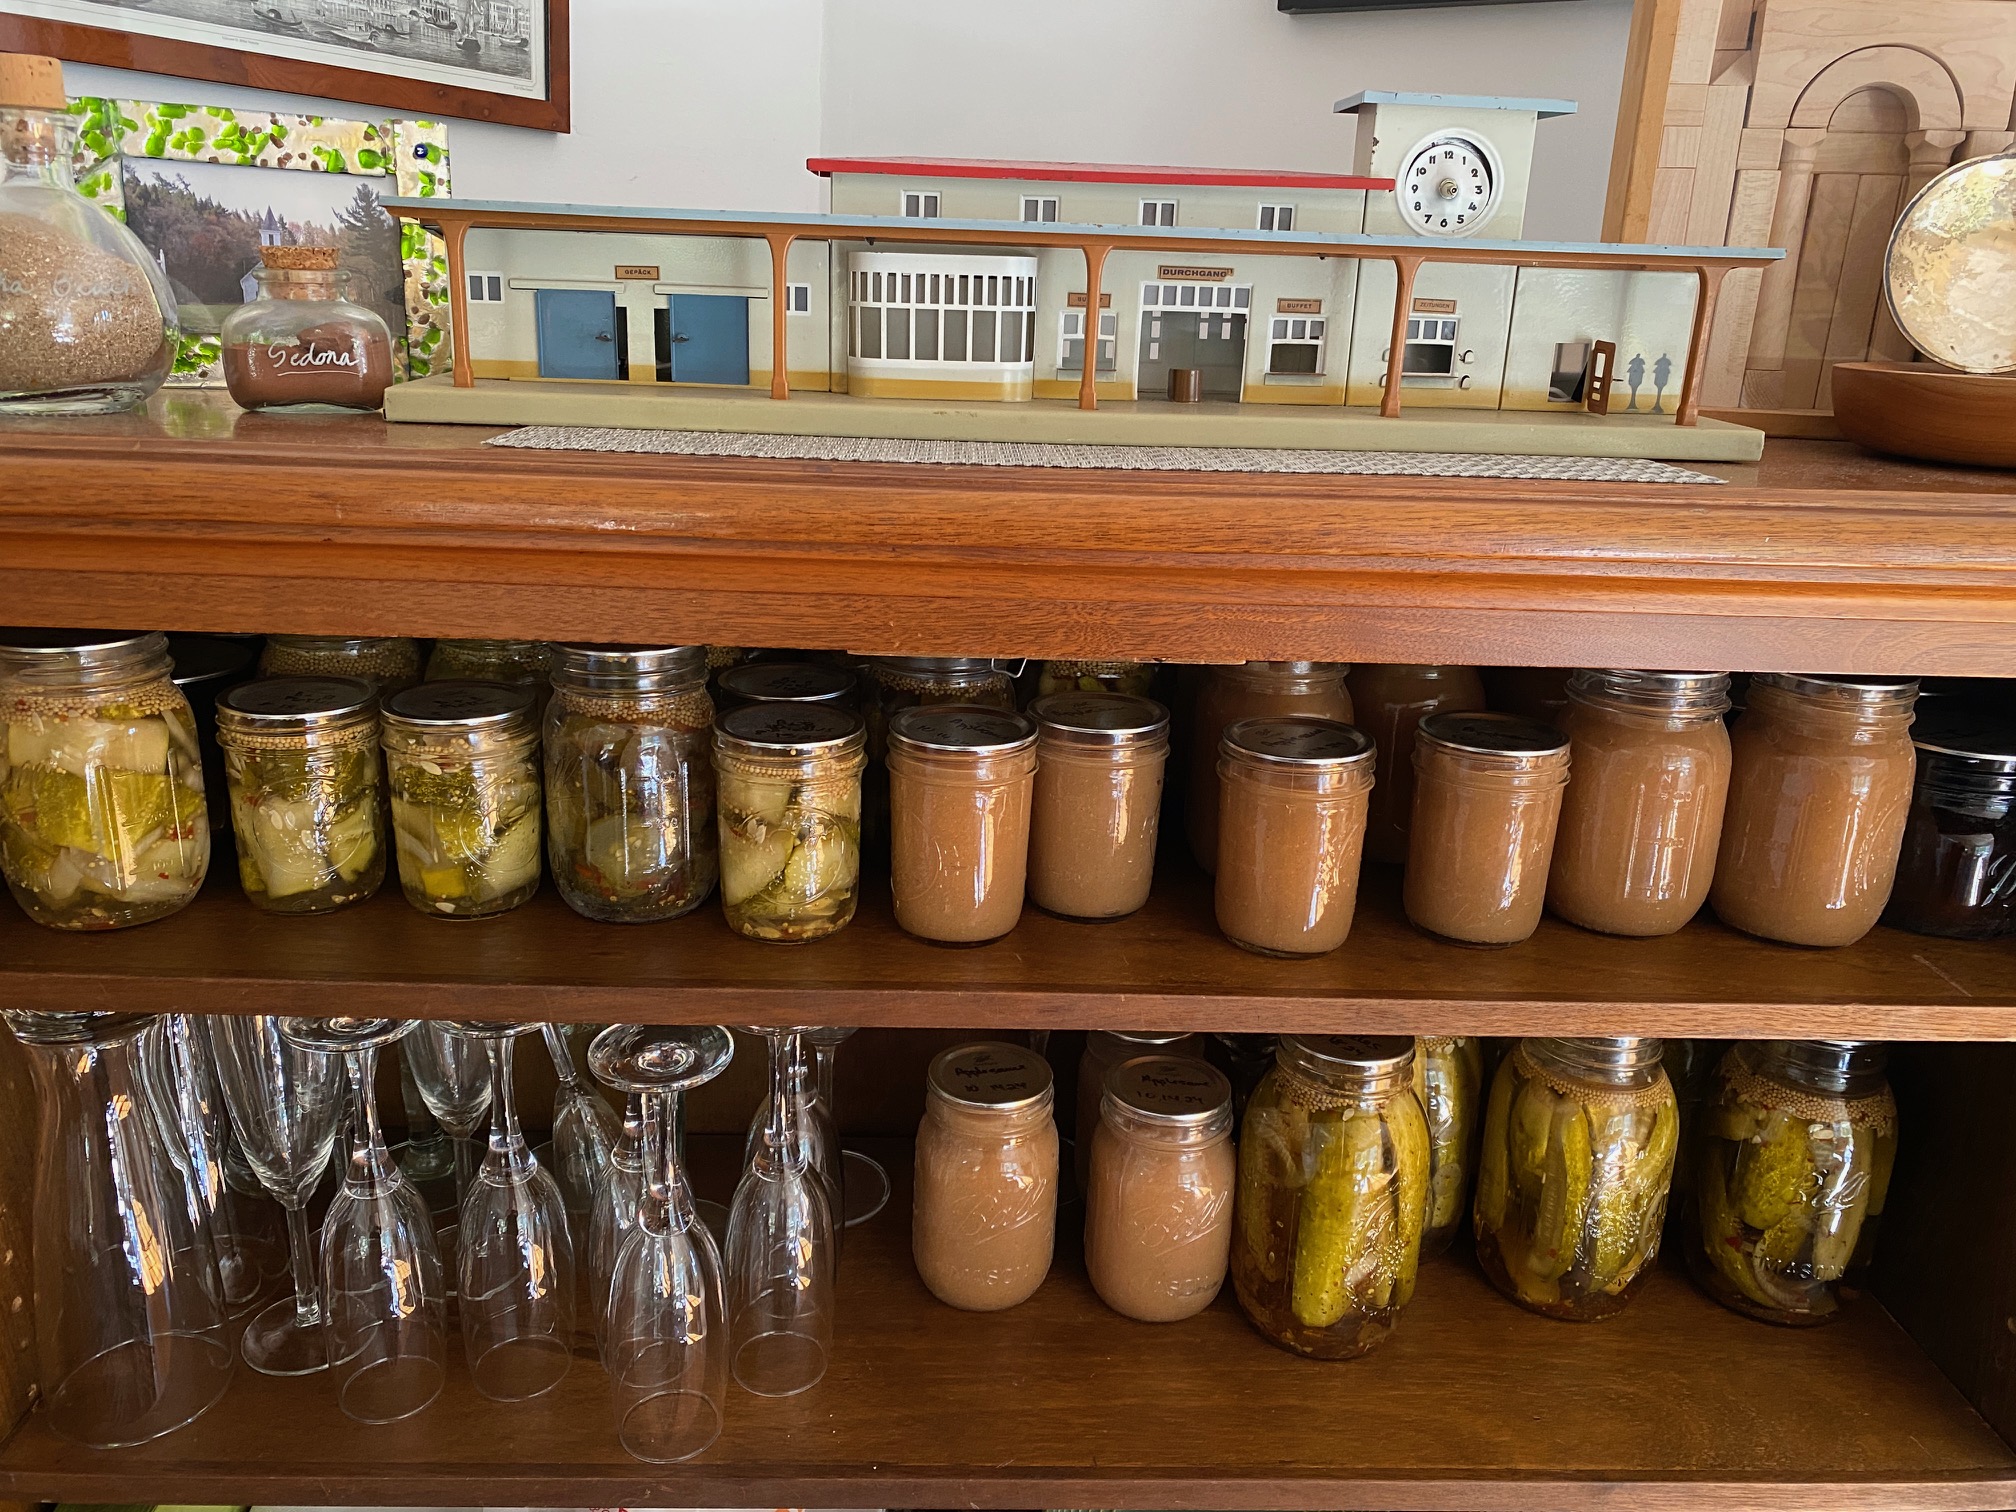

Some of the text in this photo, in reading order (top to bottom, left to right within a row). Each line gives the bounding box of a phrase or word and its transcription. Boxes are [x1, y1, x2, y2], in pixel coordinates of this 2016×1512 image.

[1429, 155, 1436, 165] 11
[1444, 150, 1454, 160] 12
[1462, 156, 1467, 165] 1
[1416, 167, 1427, 177] 10
[1471, 168, 1478, 177] 2
[1411, 184, 1419, 194] 9
[1475, 185, 1483, 195] 3
[1414, 201, 1421, 211] 8
[1468, 202, 1477, 211] 4
[1424, 214, 1432, 224] 7
[1440, 218, 1448, 228] 6
[1456, 214, 1465, 224] 5
[1162, 268, 1226, 278] DURCHGANG
[267, 340, 361, 369] Sedona
